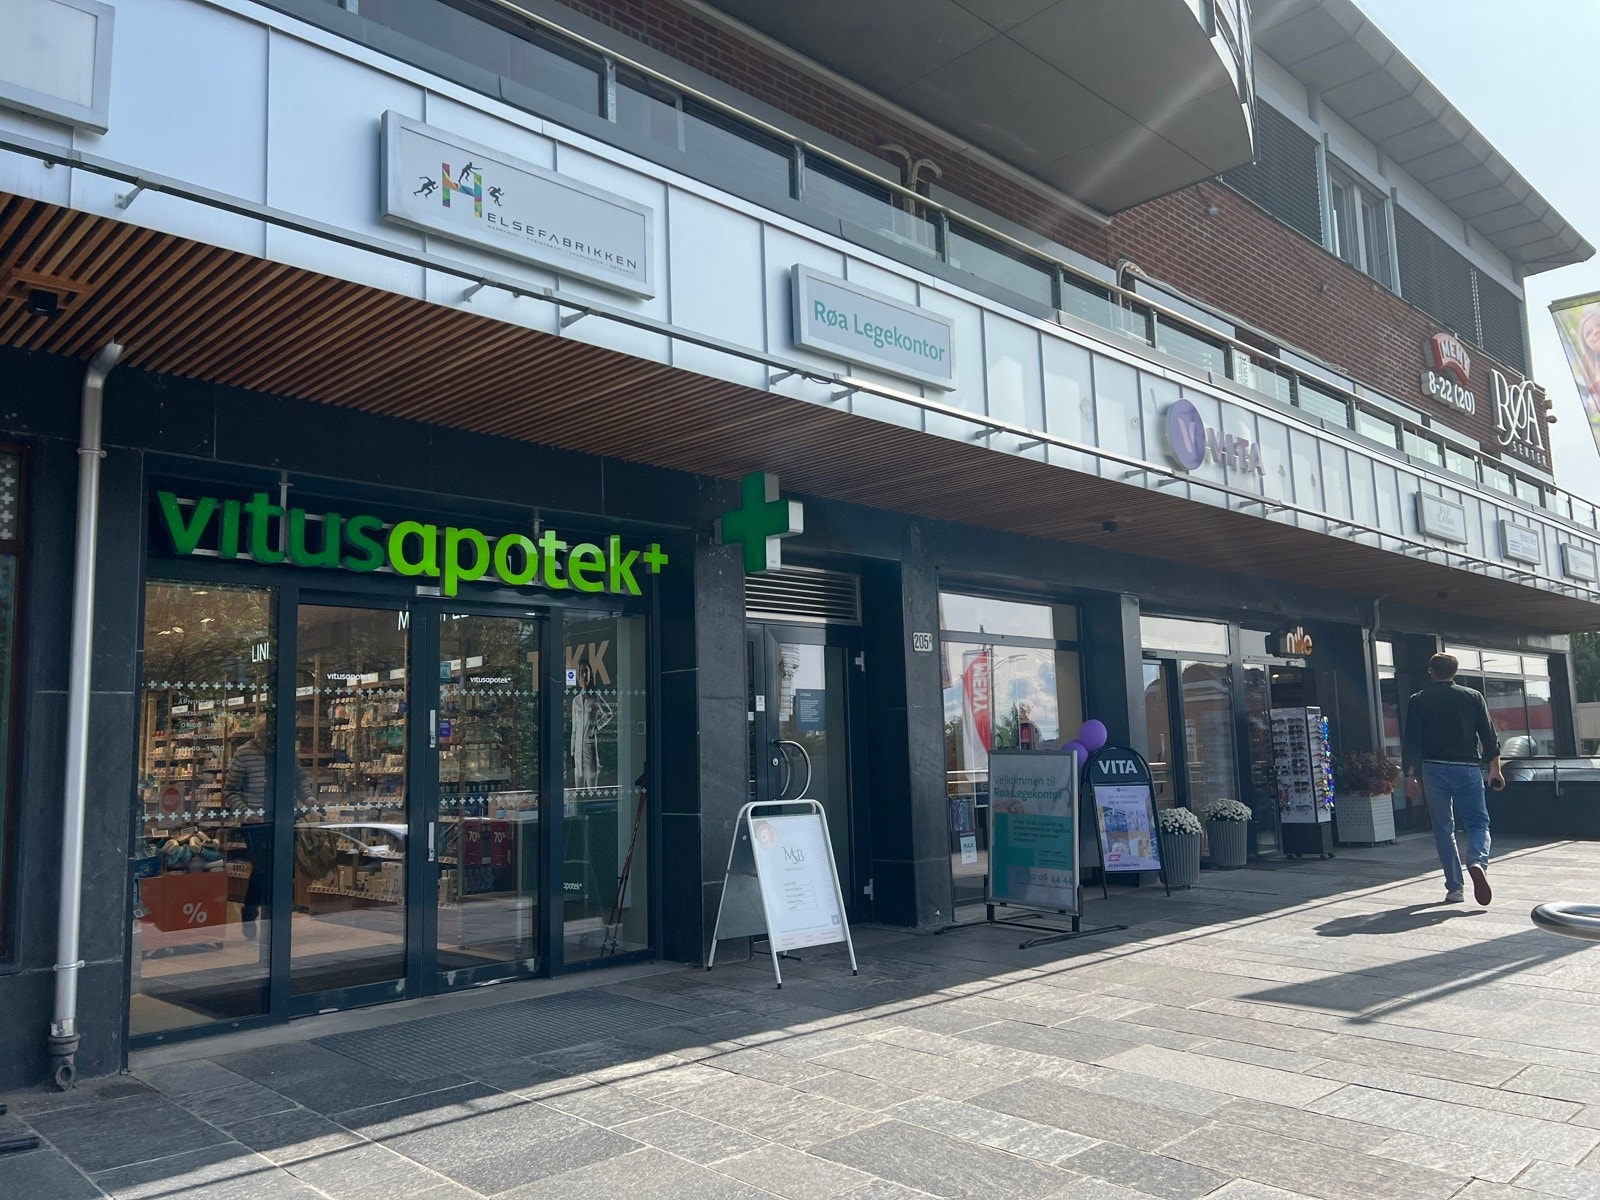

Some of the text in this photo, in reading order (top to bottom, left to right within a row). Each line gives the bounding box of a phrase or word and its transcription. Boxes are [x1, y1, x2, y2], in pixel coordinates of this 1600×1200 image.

[814, 300, 945, 362] Røa Legekontor
[1441, 339, 1470, 373] MENY
[1428, 371, 1476, 415] 8-22 (20)
[1490, 368, 1546, 451] RØA
[1206, 427, 1266, 476] VITA
[1286, 626, 1313, 656] nille
[993, 775, 1056, 787] Velkommen til
[1098, 759, 1138, 775] VITA
[1011, 787, 1063, 801] Legekontor
